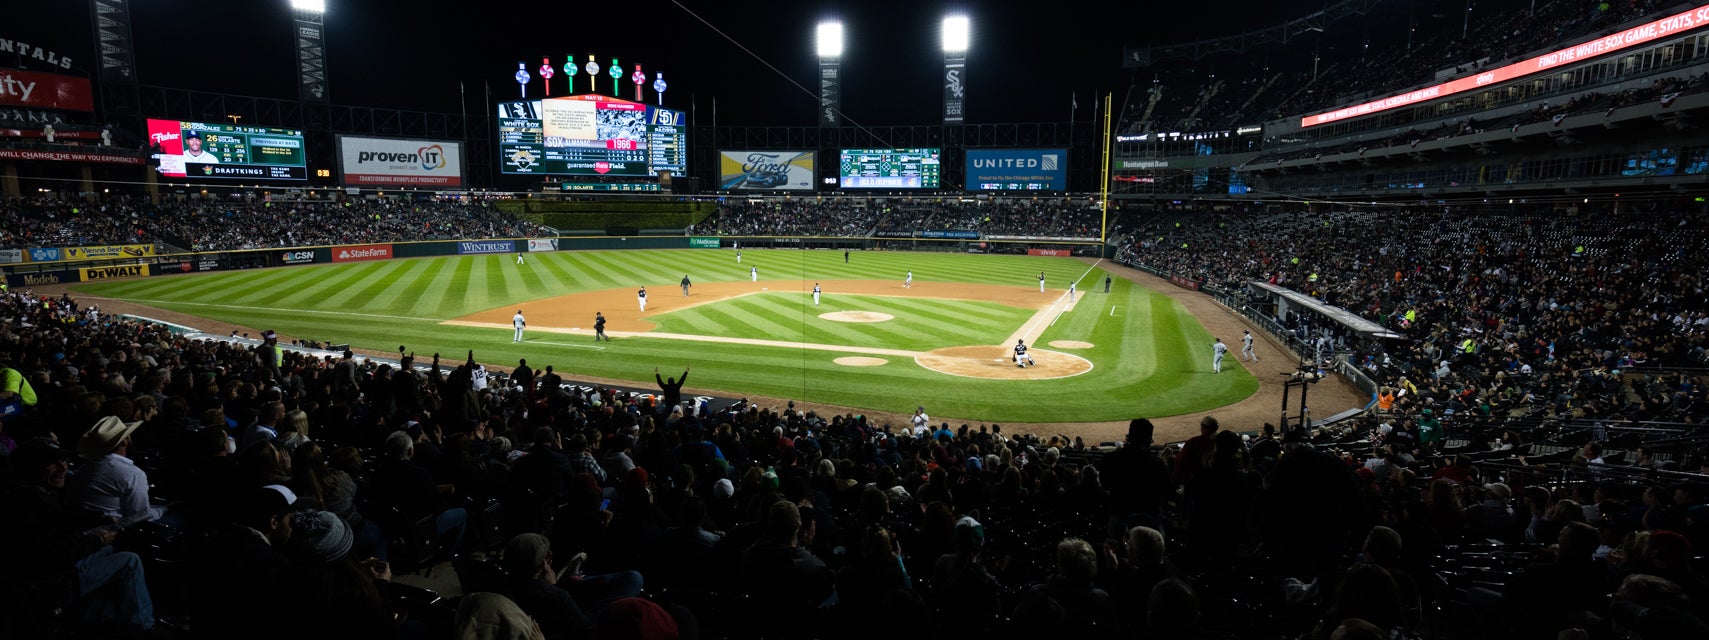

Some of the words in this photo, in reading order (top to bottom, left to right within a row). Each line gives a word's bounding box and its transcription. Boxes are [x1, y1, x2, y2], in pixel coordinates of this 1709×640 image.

[1538, 55, 1557, 68] FIND
[1559, 49, 1575, 62] THE
[1576, 41, 1604, 57] WHITE
[1605, 34, 1624, 49] SOX
[1626, 24, 1657, 44] GAME,
[1660, 13, 1694, 33] STATS,
[1386, 95, 1412, 106] SCHEDULE
[1423, 87, 1439, 98] MORE
[207, 134, 218, 142] 26
[547, 137, 564, 147] SOX
[613, 140, 631, 149] 1966
[21, 151, 57, 159] CHANGE
[358, 151, 418, 164] proven
[425, 152, 439, 164] IT
[742, 153, 792, 174] Ford
[974, 159, 1037, 168] UNITED
[1123, 161, 1154, 169] Huntington
[215, 167, 263, 175] DRAFTKINGS
[462, 242, 511, 251] WINTRUST
[295, 251, 314, 260] CSN
[24, 274, 59, 285] Modelo
[474, 370, 483, 379] 12
